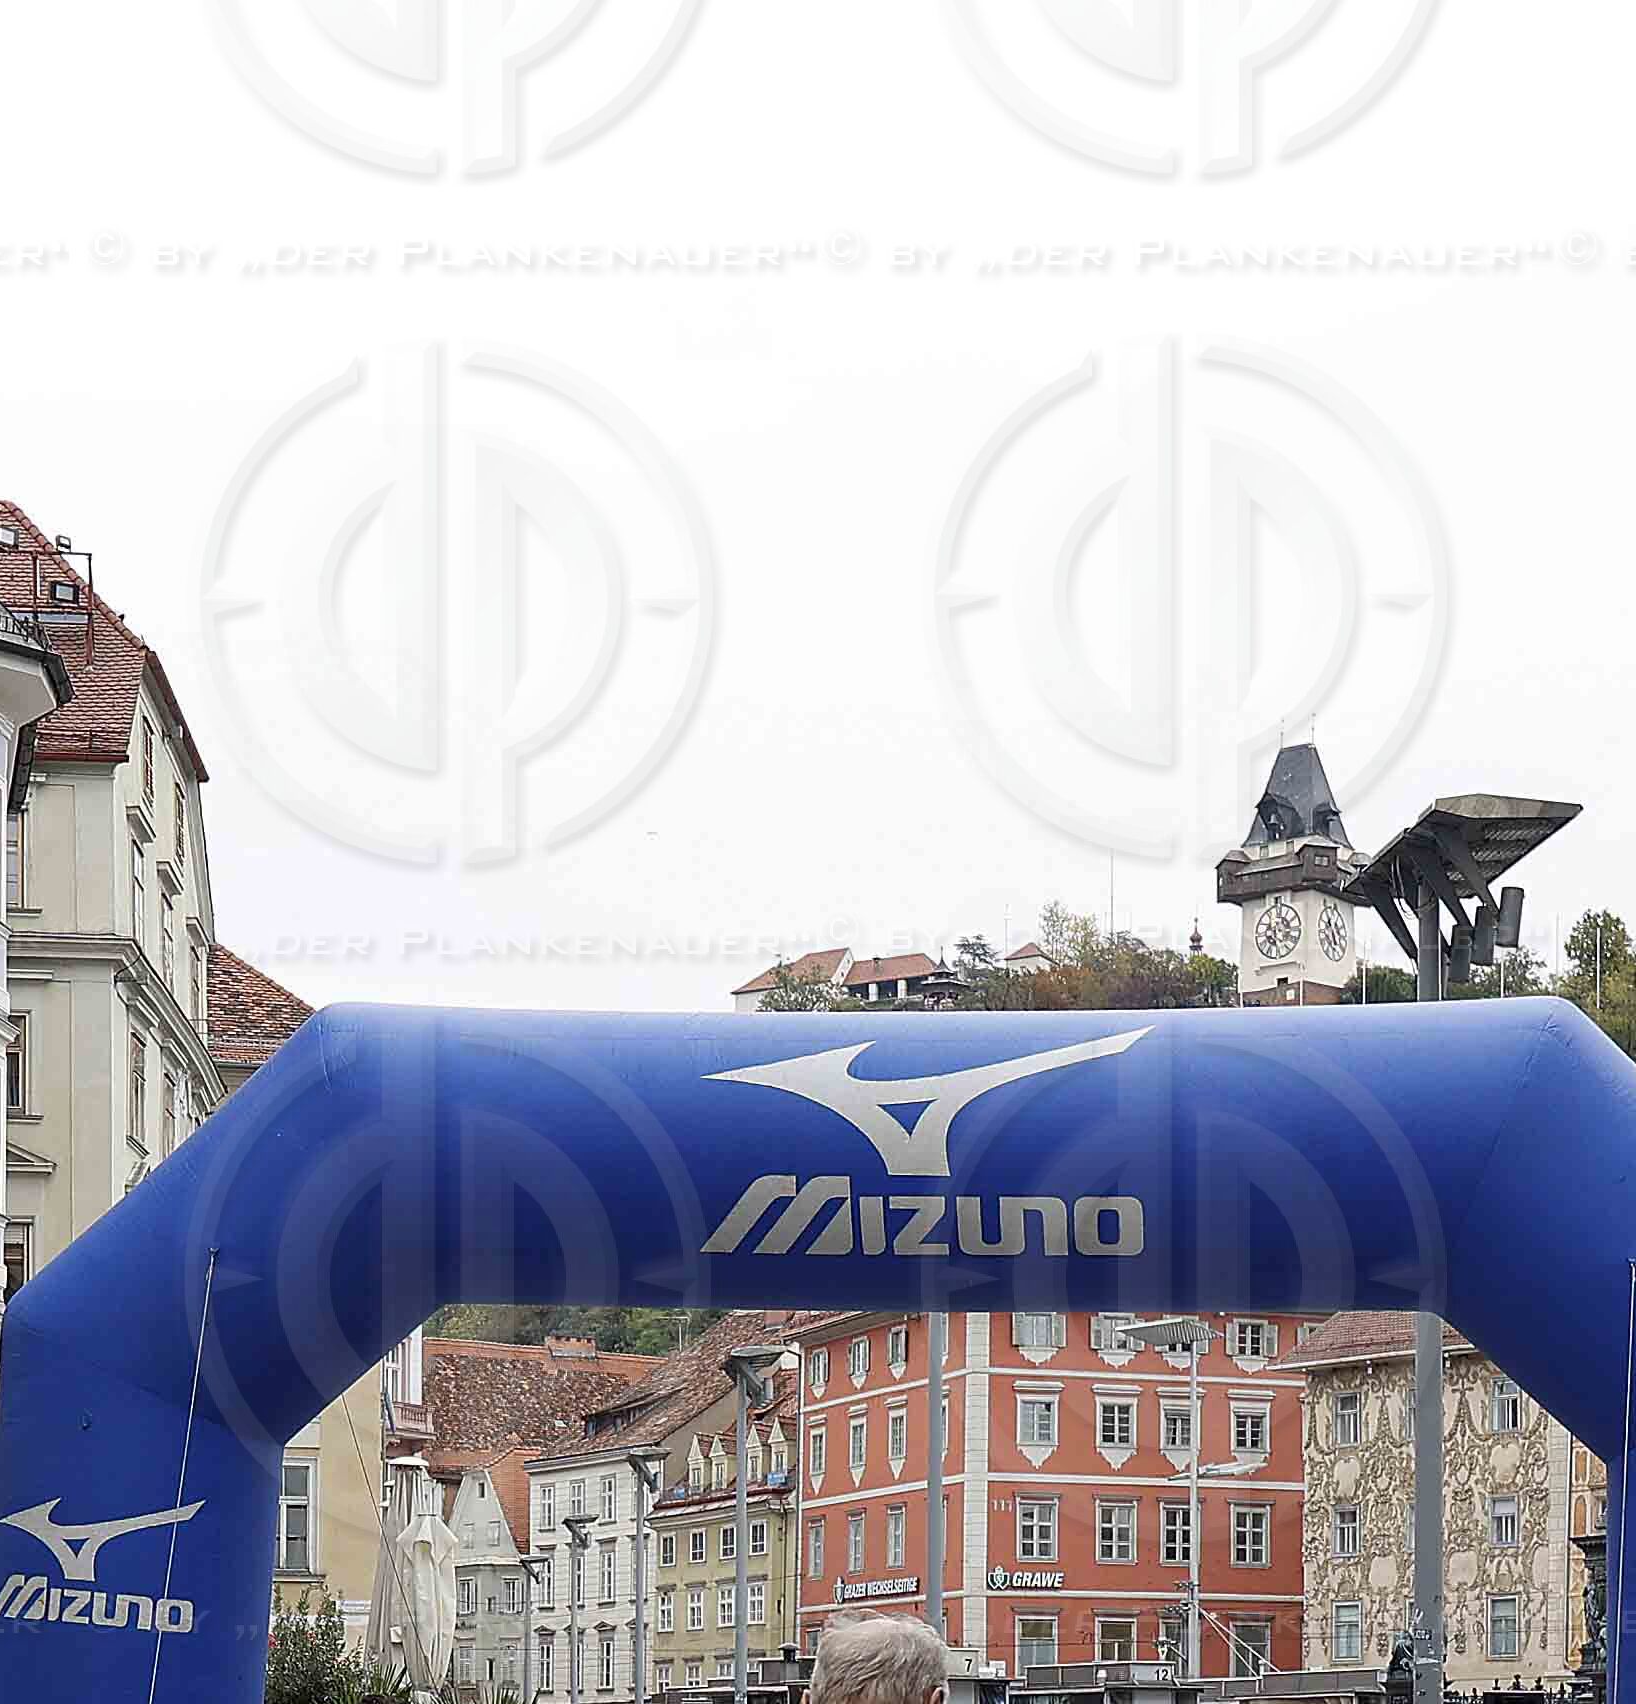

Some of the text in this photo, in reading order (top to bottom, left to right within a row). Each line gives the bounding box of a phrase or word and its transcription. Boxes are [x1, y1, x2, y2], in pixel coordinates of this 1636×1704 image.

[1012, 1572, 1064, 1587] GRAWE
[964, 1658, 973, 1672] 7
[1155, 1669, 1169, 1681] 12
